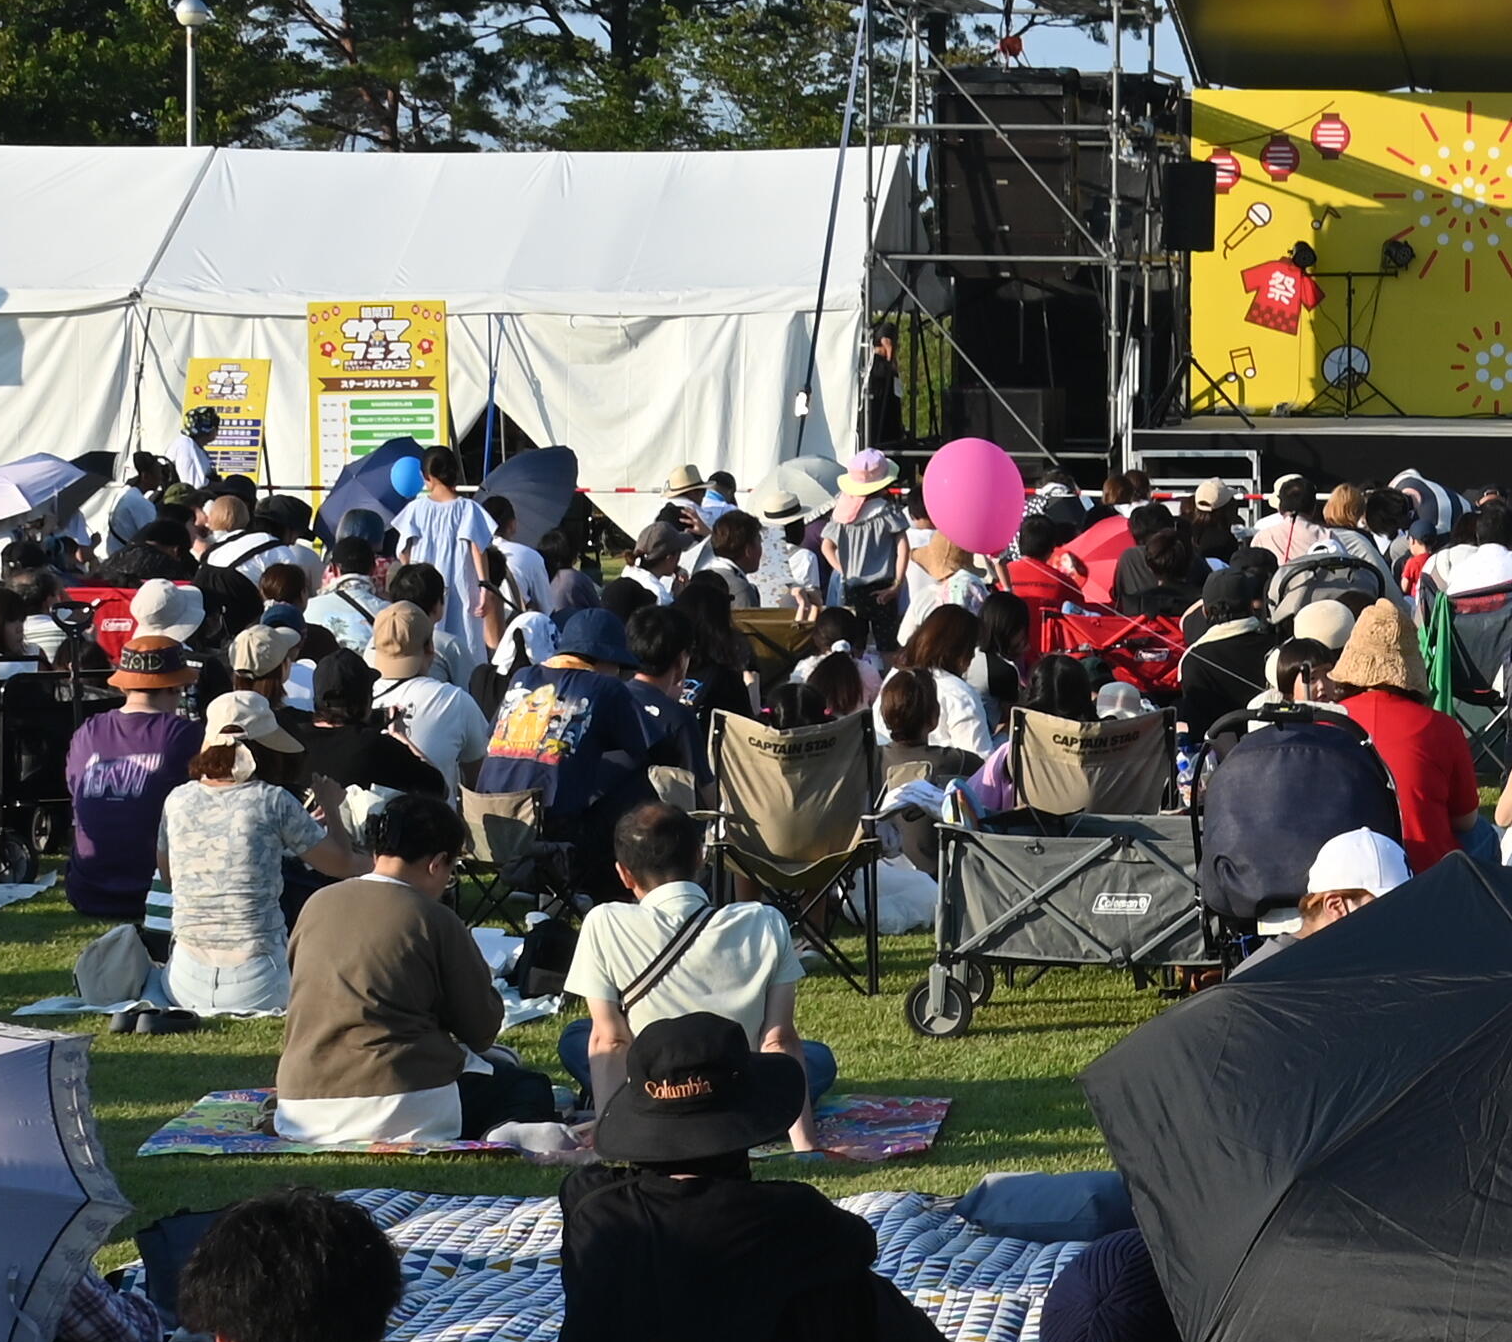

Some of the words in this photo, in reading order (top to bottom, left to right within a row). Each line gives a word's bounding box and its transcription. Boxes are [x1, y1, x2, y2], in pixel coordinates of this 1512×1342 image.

[1267, 270, 1296, 305] 祭
[372, 360, 411, 370] 2025
[340, 379, 419, 389] ステージスケジュール
[747, 736, 802, 755] CAPTAIN
[1052, 733, 1108, 749] CAPTAIN
[644, 1075, 713, 1100] Columbia
